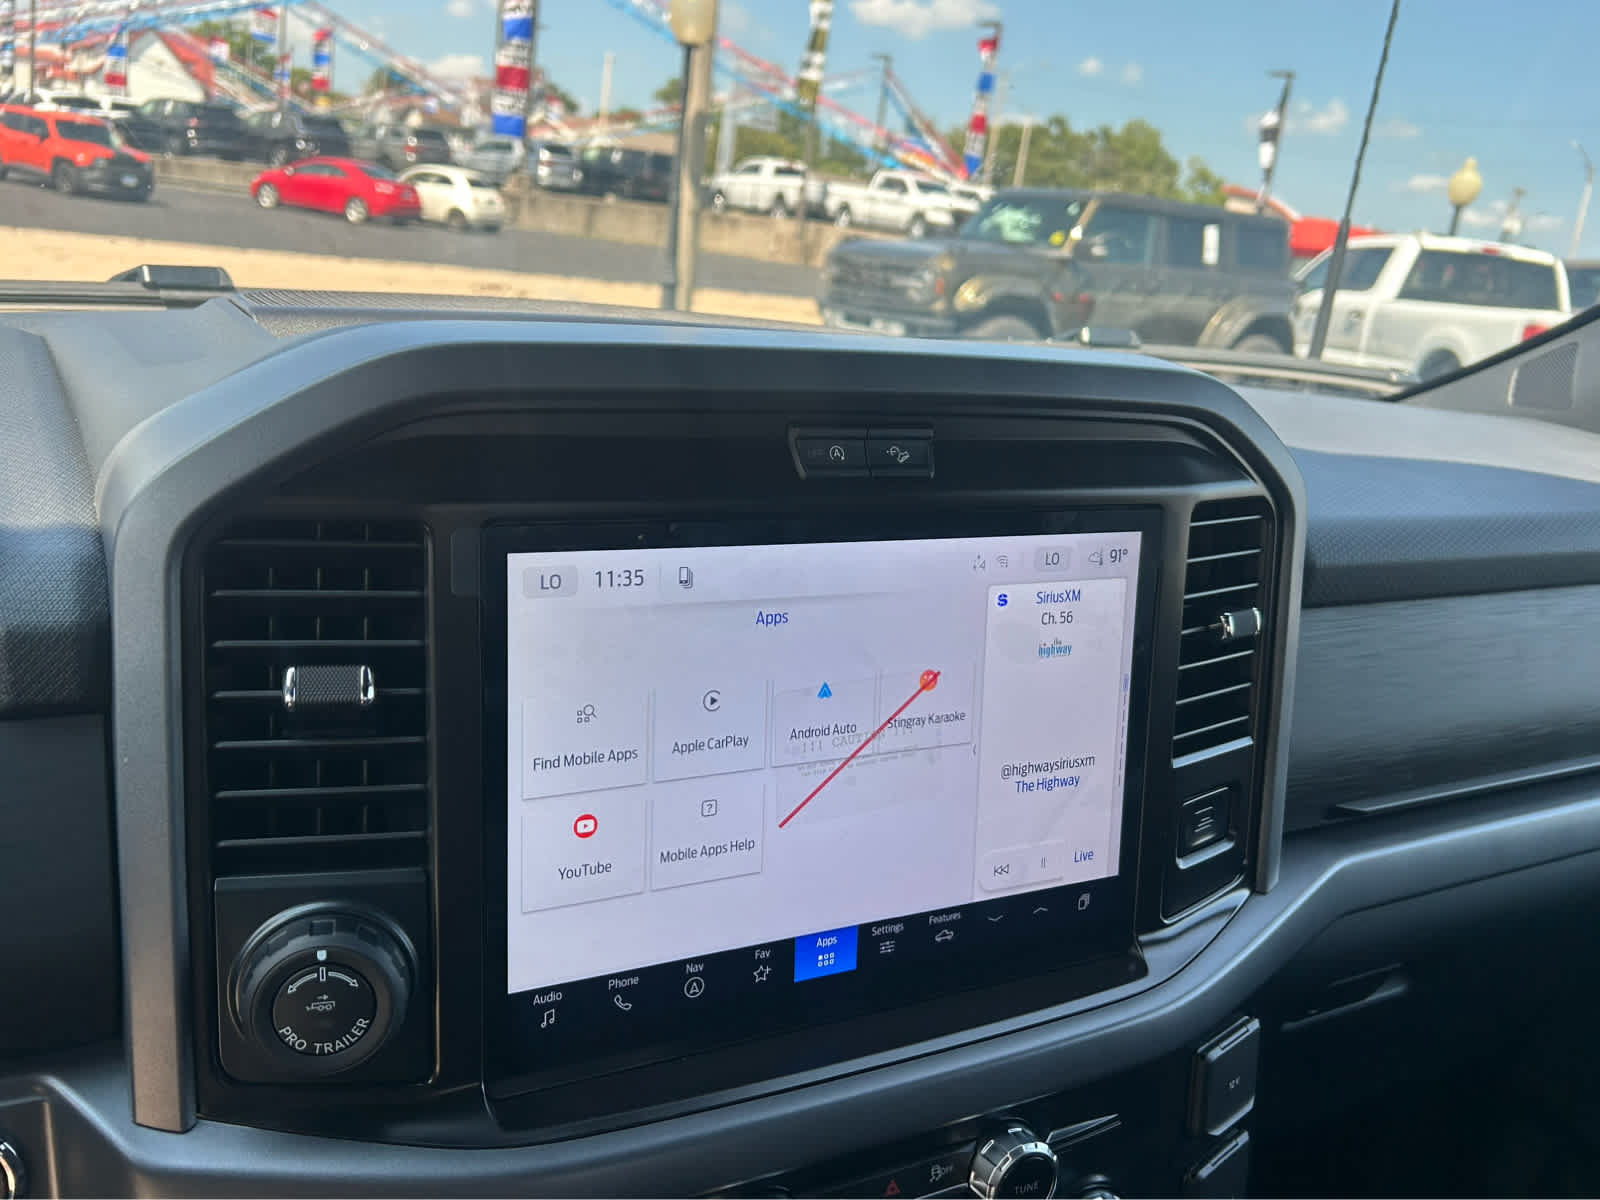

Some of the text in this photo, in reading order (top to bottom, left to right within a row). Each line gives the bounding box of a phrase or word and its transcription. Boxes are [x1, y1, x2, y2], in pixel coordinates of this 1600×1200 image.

[1045, 552, 1060, 566] LO
[540, 574, 562, 590] LO
[595, 569, 645, 588] 11:35
[1036, 589, 1081, 605] SiriusXM
[755, 610, 789, 627] Apps
[1041, 610, 1074, 626] Ch. 56
[1038, 643, 1072, 659] highway
[887, 710, 967, 731] Stingray Karaoke
[790, 722, 857, 741] Android Auto
[672, 735, 750, 755] Apple CarPlay
[533, 748, 638, 771] Find Mobile Apps
[1000, 755, 1095, 780] @highwaysiriusxm
[1015, 776, 1080, 793] The Highway
[659, 837, 756, 865] Mobile Apps Help
[1073, 850, 1095, 863] Live
[558, 861, 612, 880] YouTube
[929, 910, 962, 925] Features
[871, 922, 905, 937] Settings
[816, 935, 838, 949] Apps
[754, 949, 771, 960] Fav
[686, 962, 704, 974] Nav
[608, 975, 639, 991] Phone
[533, 990, 563, 1006] Audio
[278, 1017, 370, 1055] PRO TRAILER
[1014, 1180, 1040, 1195] TUNE
